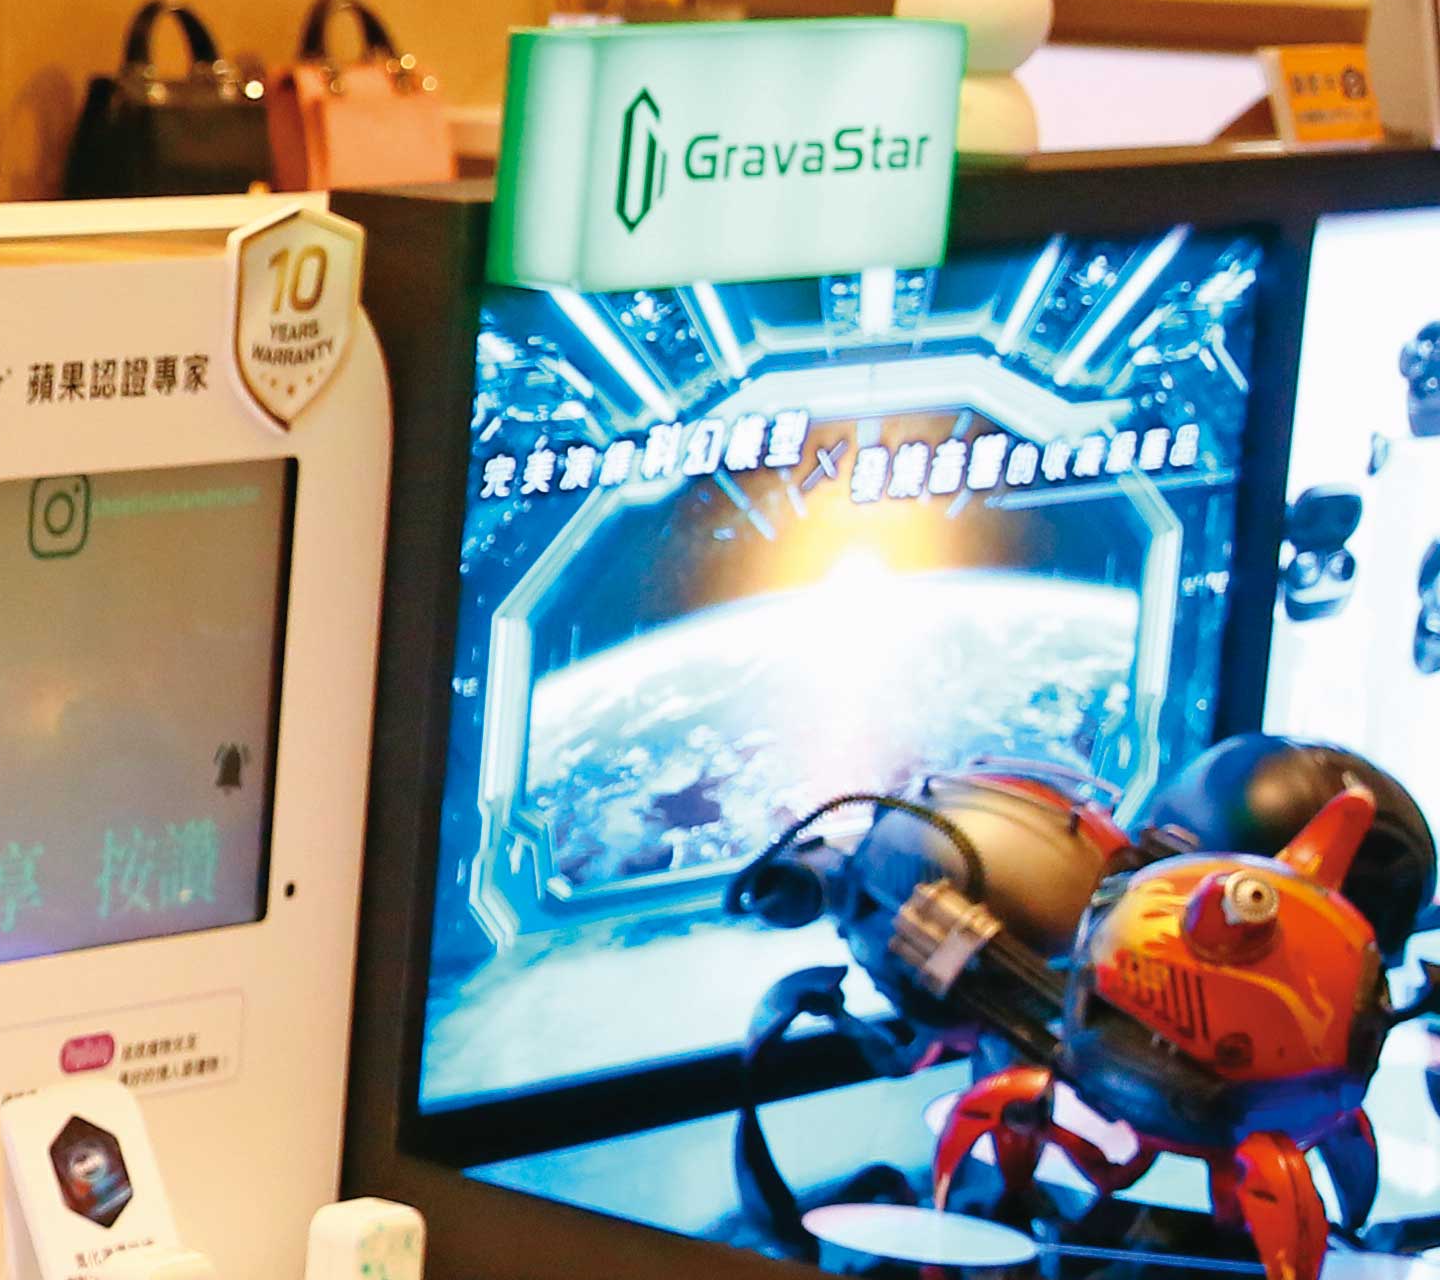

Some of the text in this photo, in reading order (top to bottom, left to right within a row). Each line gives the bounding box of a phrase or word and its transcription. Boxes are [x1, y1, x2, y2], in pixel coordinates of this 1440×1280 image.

[685, 126, 928, 183] GravaStar
[266, 245, 330, 314] 10
[251, 339, 333, 367] WARRANTY
[268, 321, 319, 342] YEARS
[26, 354, 210, 404] 蘋果認證專家
